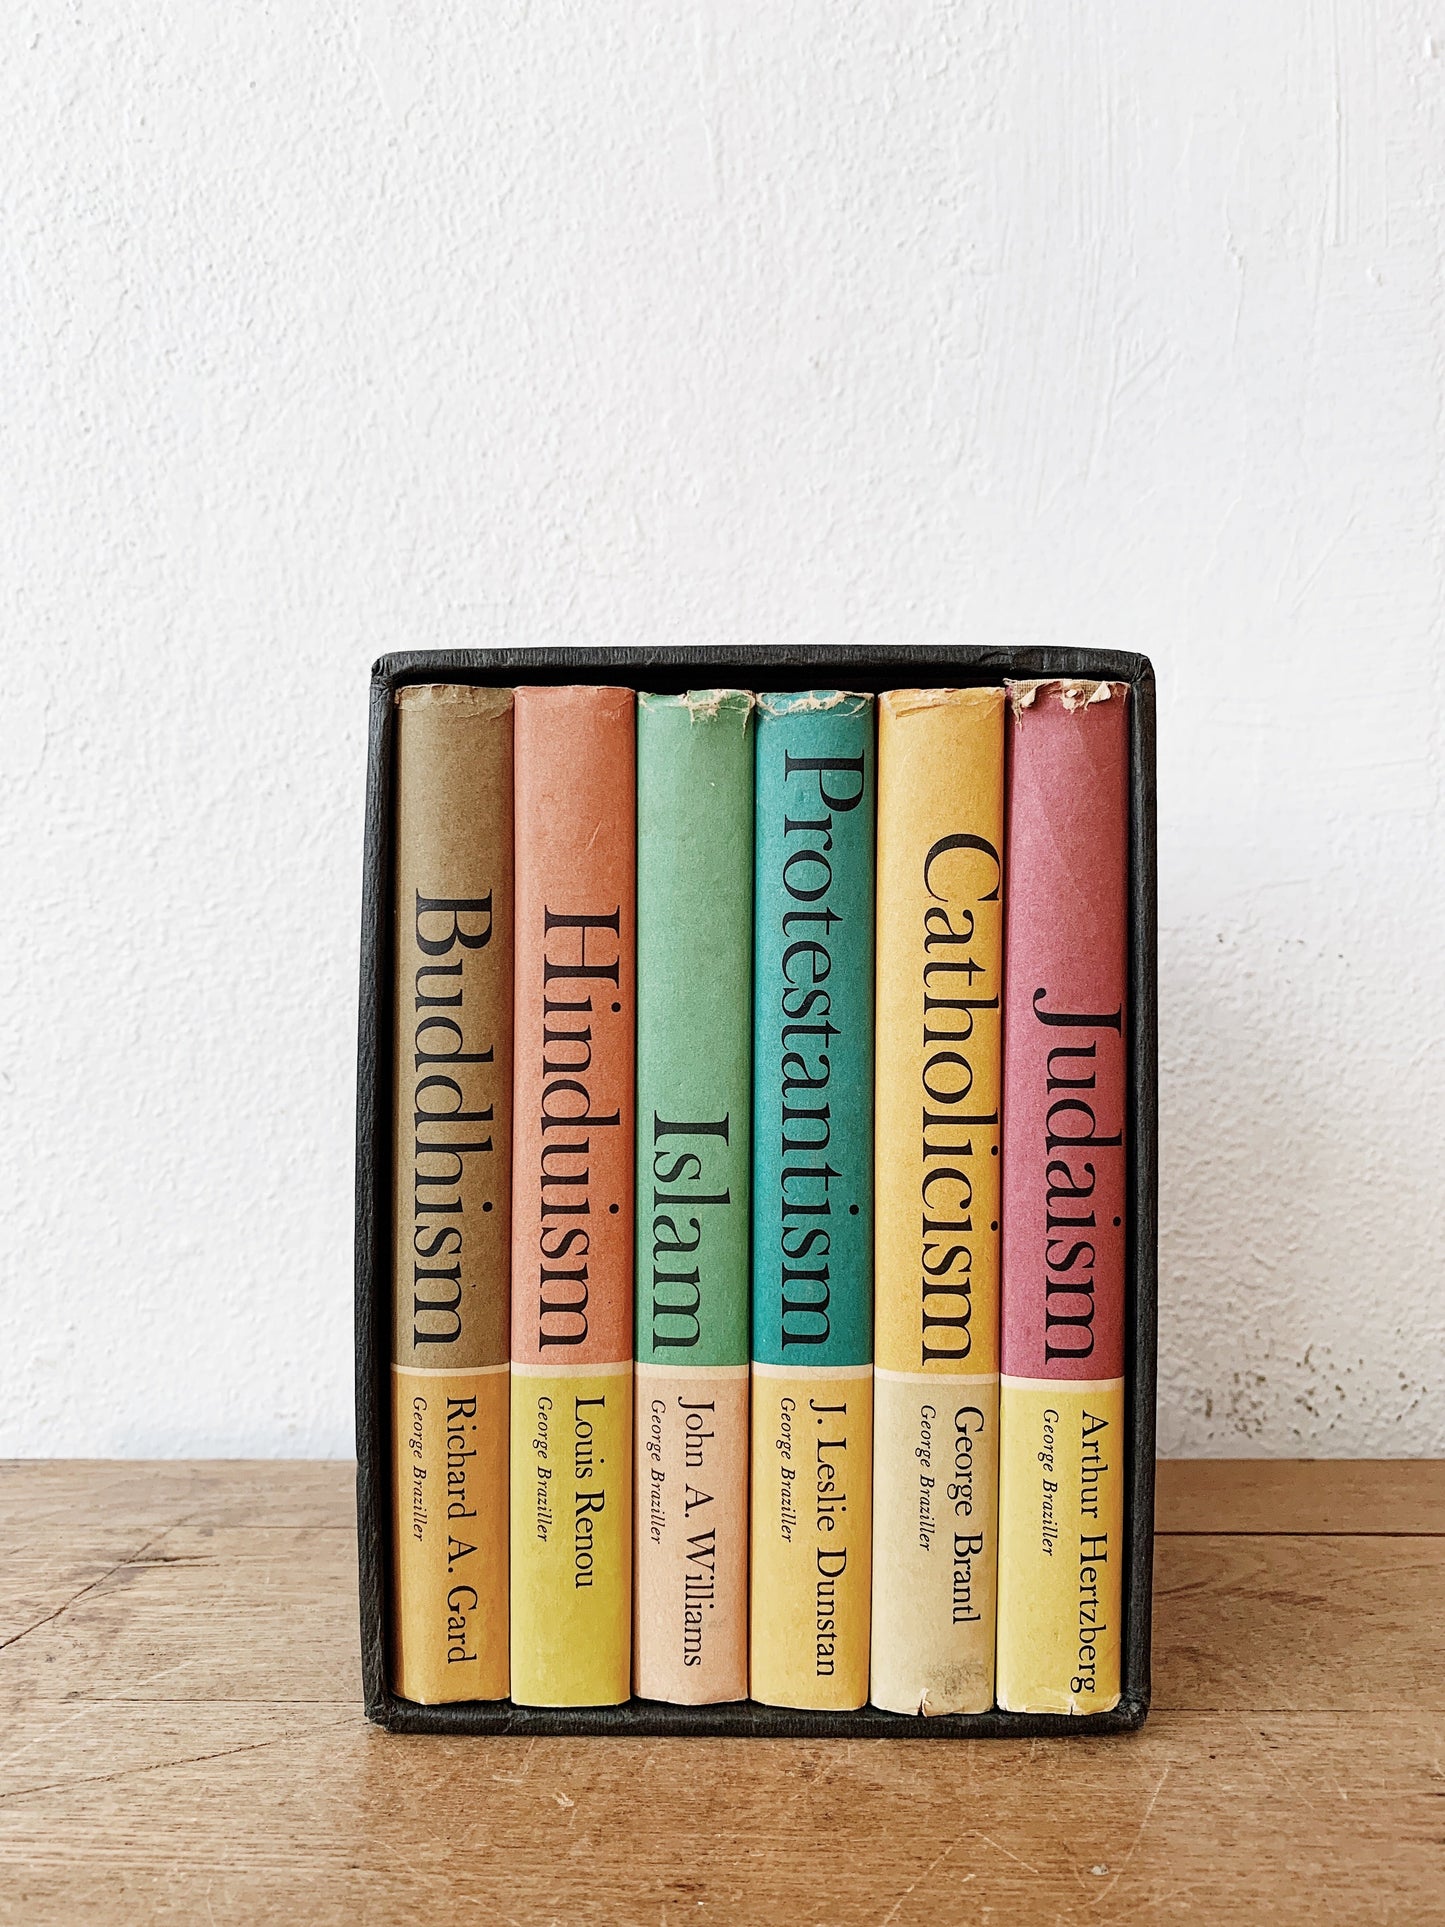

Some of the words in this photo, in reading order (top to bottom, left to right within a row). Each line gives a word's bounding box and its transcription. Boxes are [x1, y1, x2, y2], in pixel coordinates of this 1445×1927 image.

[780, 749, 864, 1348] Protestantism
[412, 888, 495, 1349] Buddhism
[538, 904, 621, 1352] Hinduism
[921, 833, 1001, 1364] Catholicism
[1034, 988, 1123, 1363] Judaism
[652, 1112, 731, 1352] Islam
[408, 1397, 428, 1459] George
[533, 1396, 553, 1459] George
[575, 1396, 605, 1478] Louis
[646, 1400, 666, 1462] George
[678, 1396, 715, 1467] John
[775, 1398, 796, 1460] George
[810, 1399, 847, 1424] J.
[915, 1405, 936, 1467] George
[1038, 1408, 1059, 1472] George
[446, 1395, 477, 1519] Richard
[816, 1438, 847, 1531] Leslie
[947, 1406, 985, 1516] George
[1080, 1410, 1109, 1518] Arthur
[412, 1467, 428, 1541] Braziller
[537, 1467, 553, 1542] Braziller
[575, 1490, 605, 1589] Renou
[651, 1469, 666, 1544] Braziller
[684, 1484, 714, 1517] A.
[780, 1467, 796, 1542] Braziller
[919, 1475, 935, 1551] Braziller
[1042, 1480, 1059, 1556] Braziller
[448, 1536, 477, 1573] A.
[952, 1532, 983, 1624] Brantl
[446, 1585, 478, 1664] Gard
[684, 1528, 716, 1667] Williams
[816, 1548, 847, 1677] Dunstan
[1070, 1532, 1107, 1693] Hertzberg
